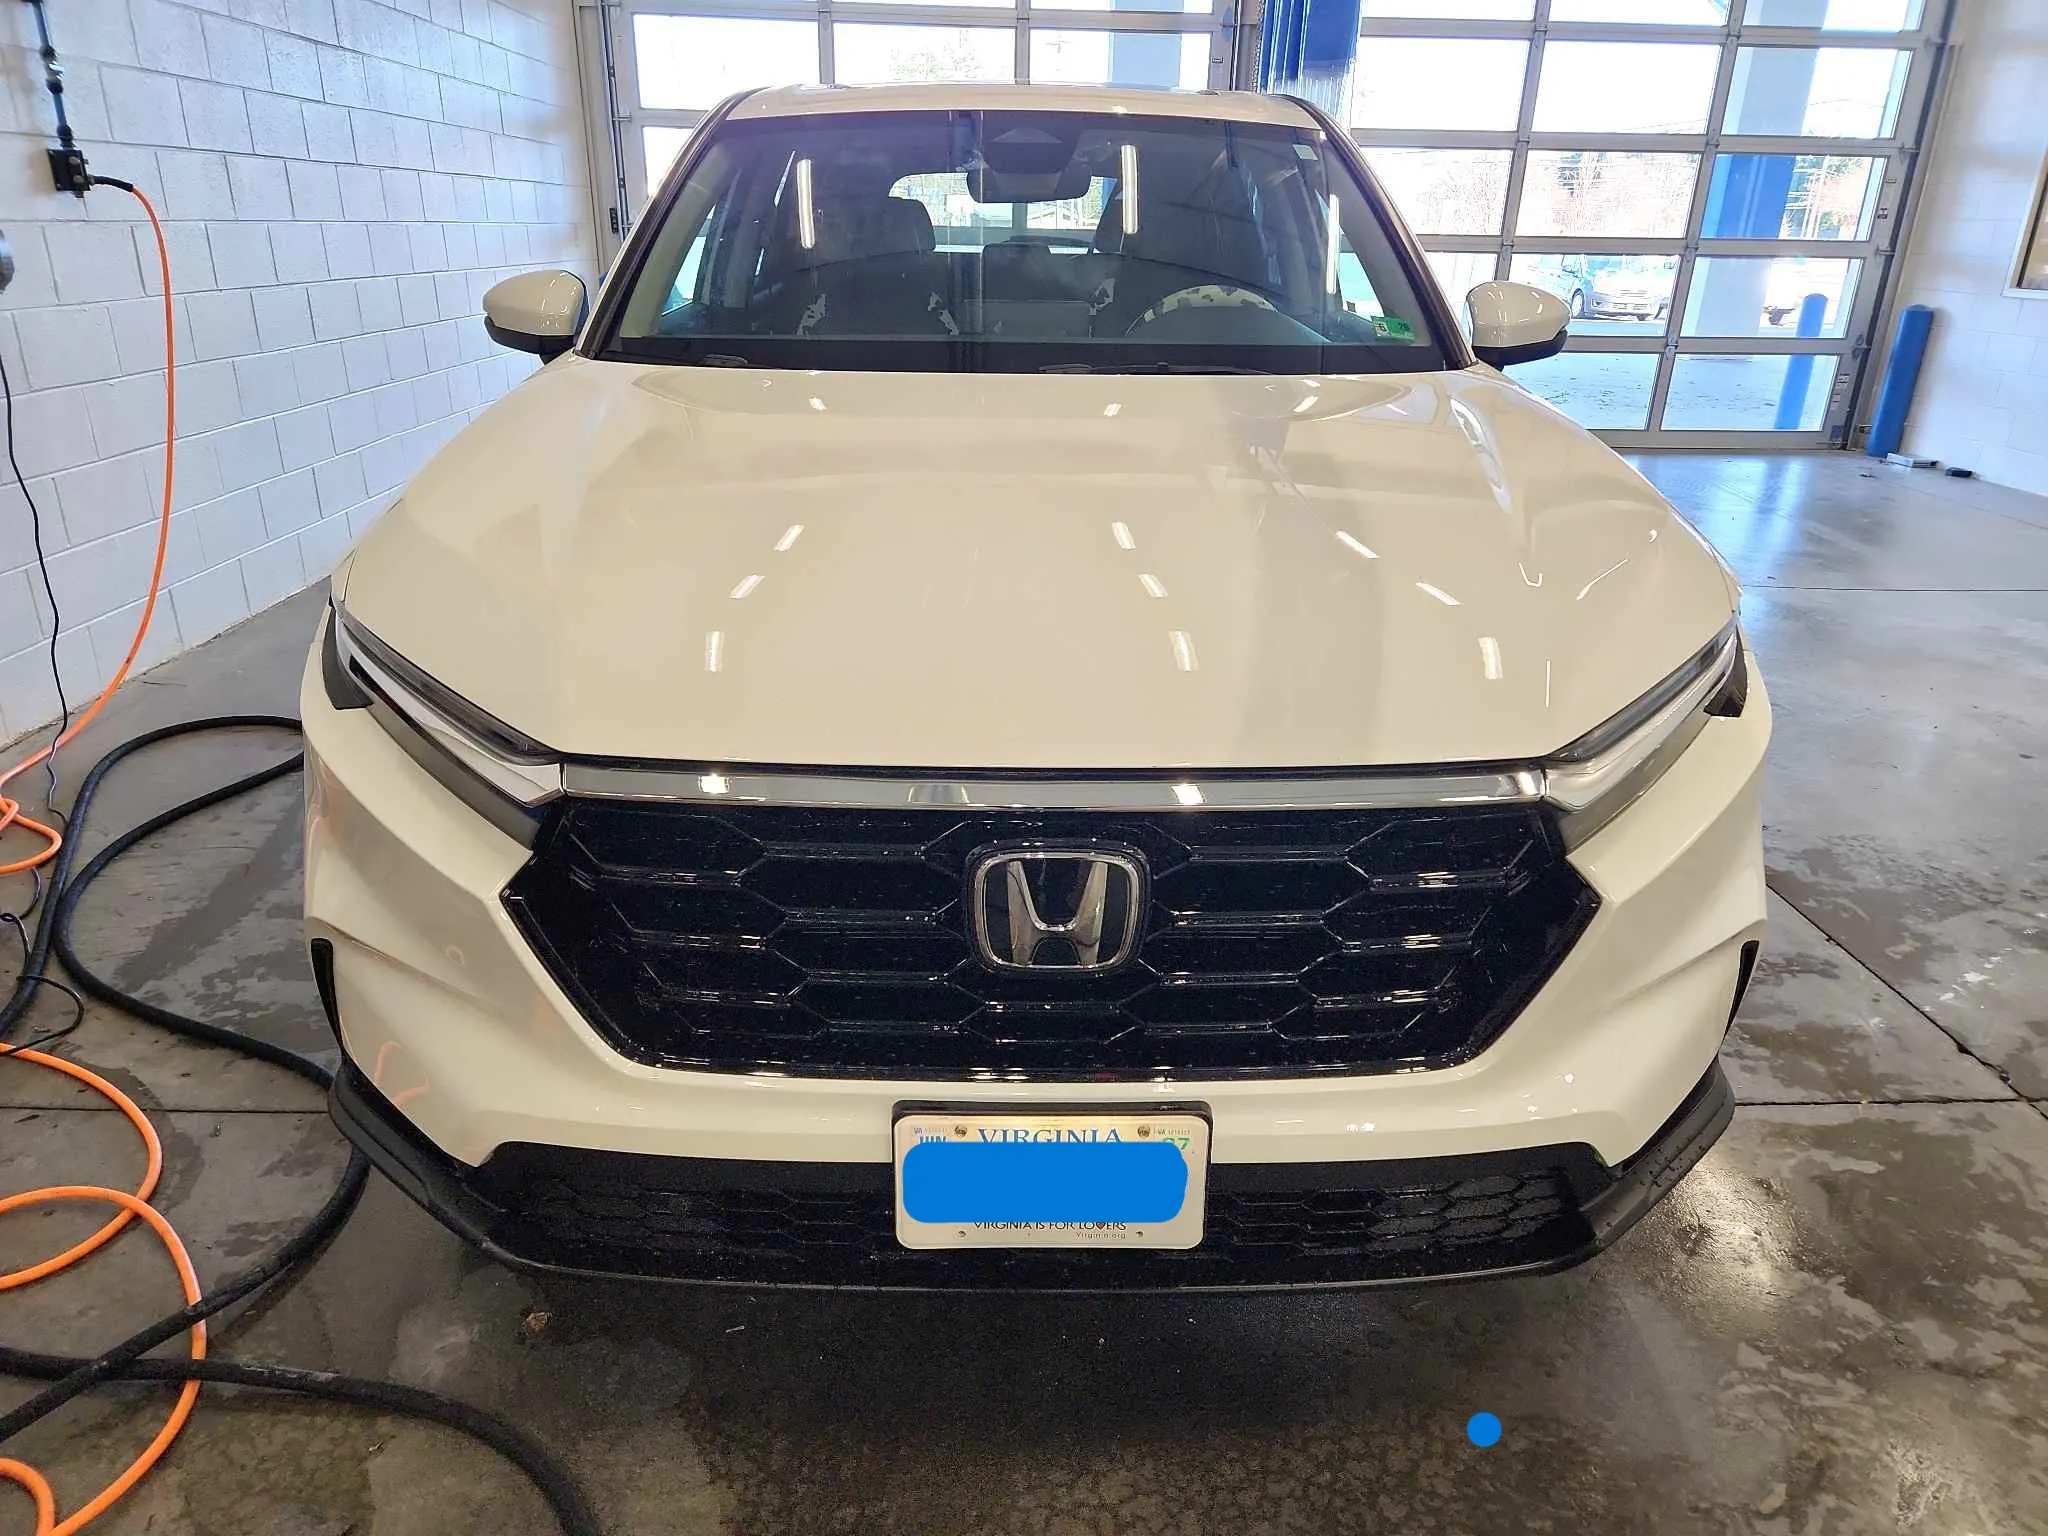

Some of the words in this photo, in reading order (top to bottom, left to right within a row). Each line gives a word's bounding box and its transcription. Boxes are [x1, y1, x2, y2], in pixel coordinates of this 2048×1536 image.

[978, 1128, 1123, 1142] VIRGINIA
[974, 1222, 1033, 1230] VIRGINIA
[1036, 1222, 1045, 1230] IS
[1050, 1222, 1075, 1230] FOR
